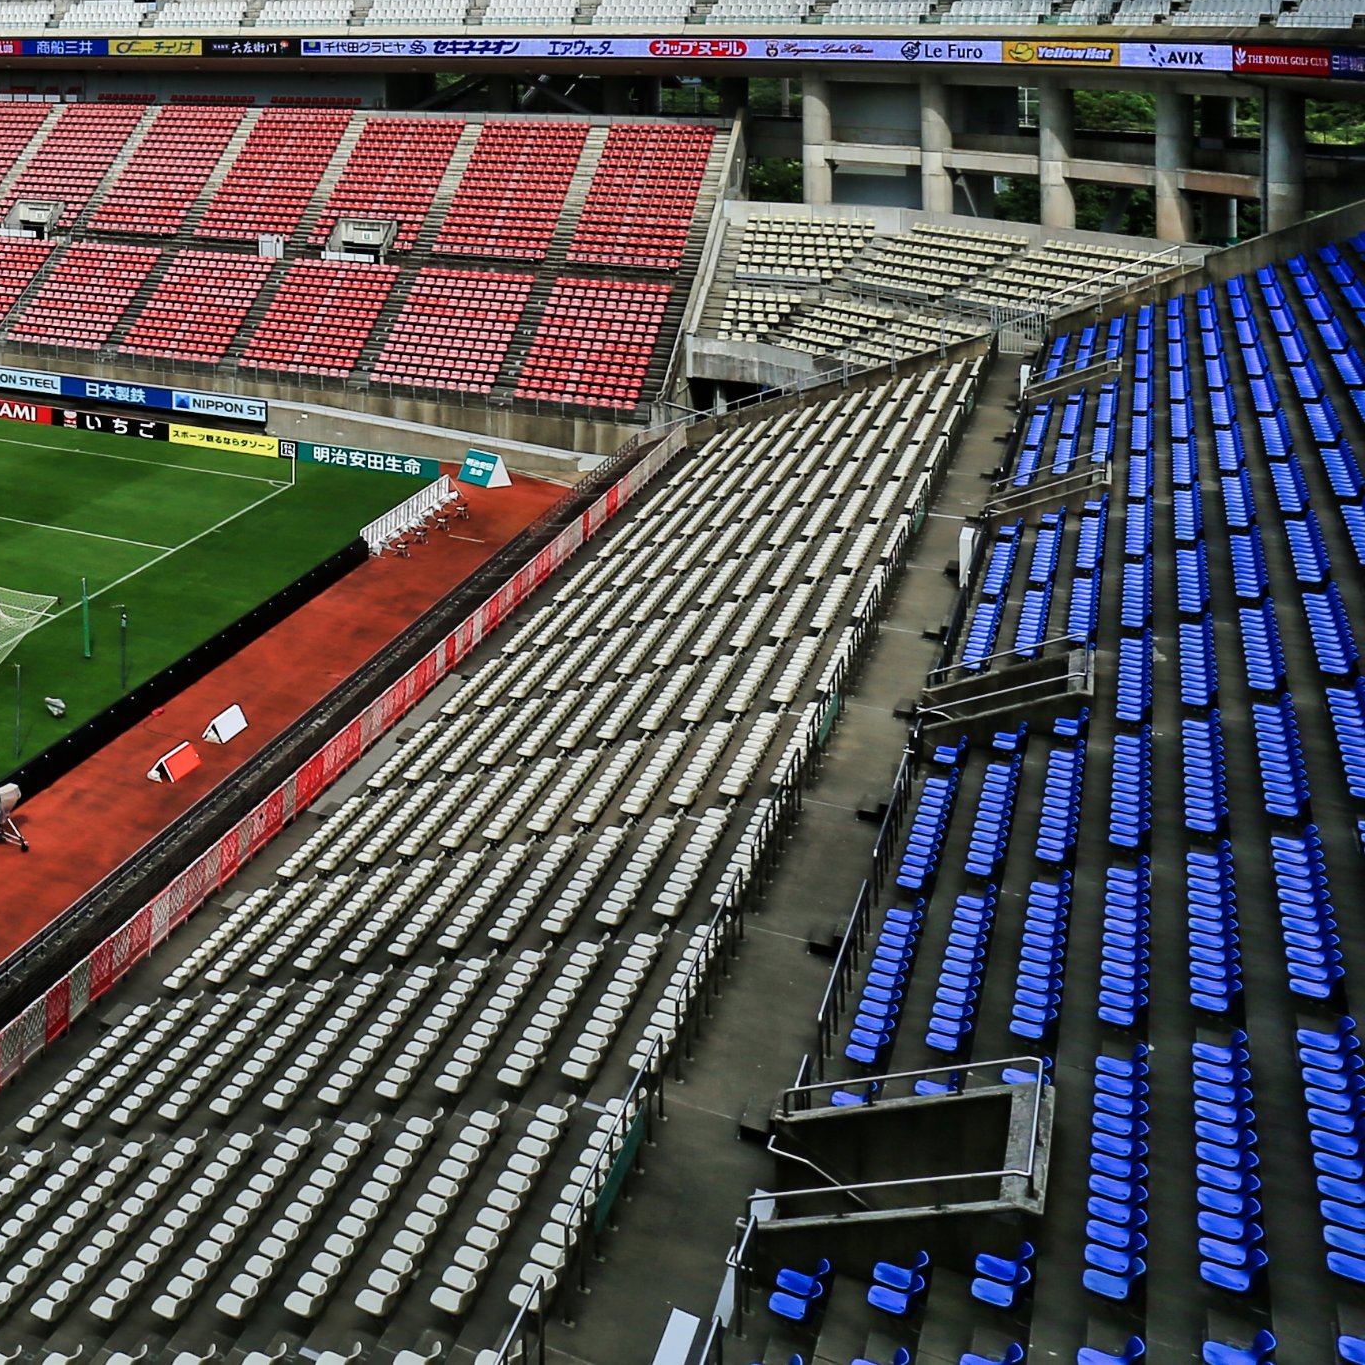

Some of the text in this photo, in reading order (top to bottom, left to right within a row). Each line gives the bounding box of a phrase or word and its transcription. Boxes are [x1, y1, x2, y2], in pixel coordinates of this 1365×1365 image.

[37, 40, 93, 54] 商船三井
[153, 41, 195, 53] チェリオ
[324, 41, 406, 54] 千代田グラビヤ
[433, 41, 520, 54] セキネネオン
[655, 42, 742, 56] カップヌードル
[925, 46, 983, 58] Le Furo
[1168, 52, 1204, 64] AVIX
[1247, 54, 1263, 64] THE
[1265, 55, 1289, 65] ROYAL
[1290, 56, 1309, 66] GOLF
[1310, 57, 1329, 67] CLUB
[20, 377, 58, 389] STEEL
[86, 382, 145, 403] 日本製鉄
[193, 398, 265, 417] NIPPON ST
[86, 415, 155, 439] いちご
[173, 430, 274, 451] スポーツ観るならダゾーン
[313, 446, 421, 475] 明治安田生命
[465, 458, 494, 471] 明治安田
[469, 468, 483, 477] 生命
